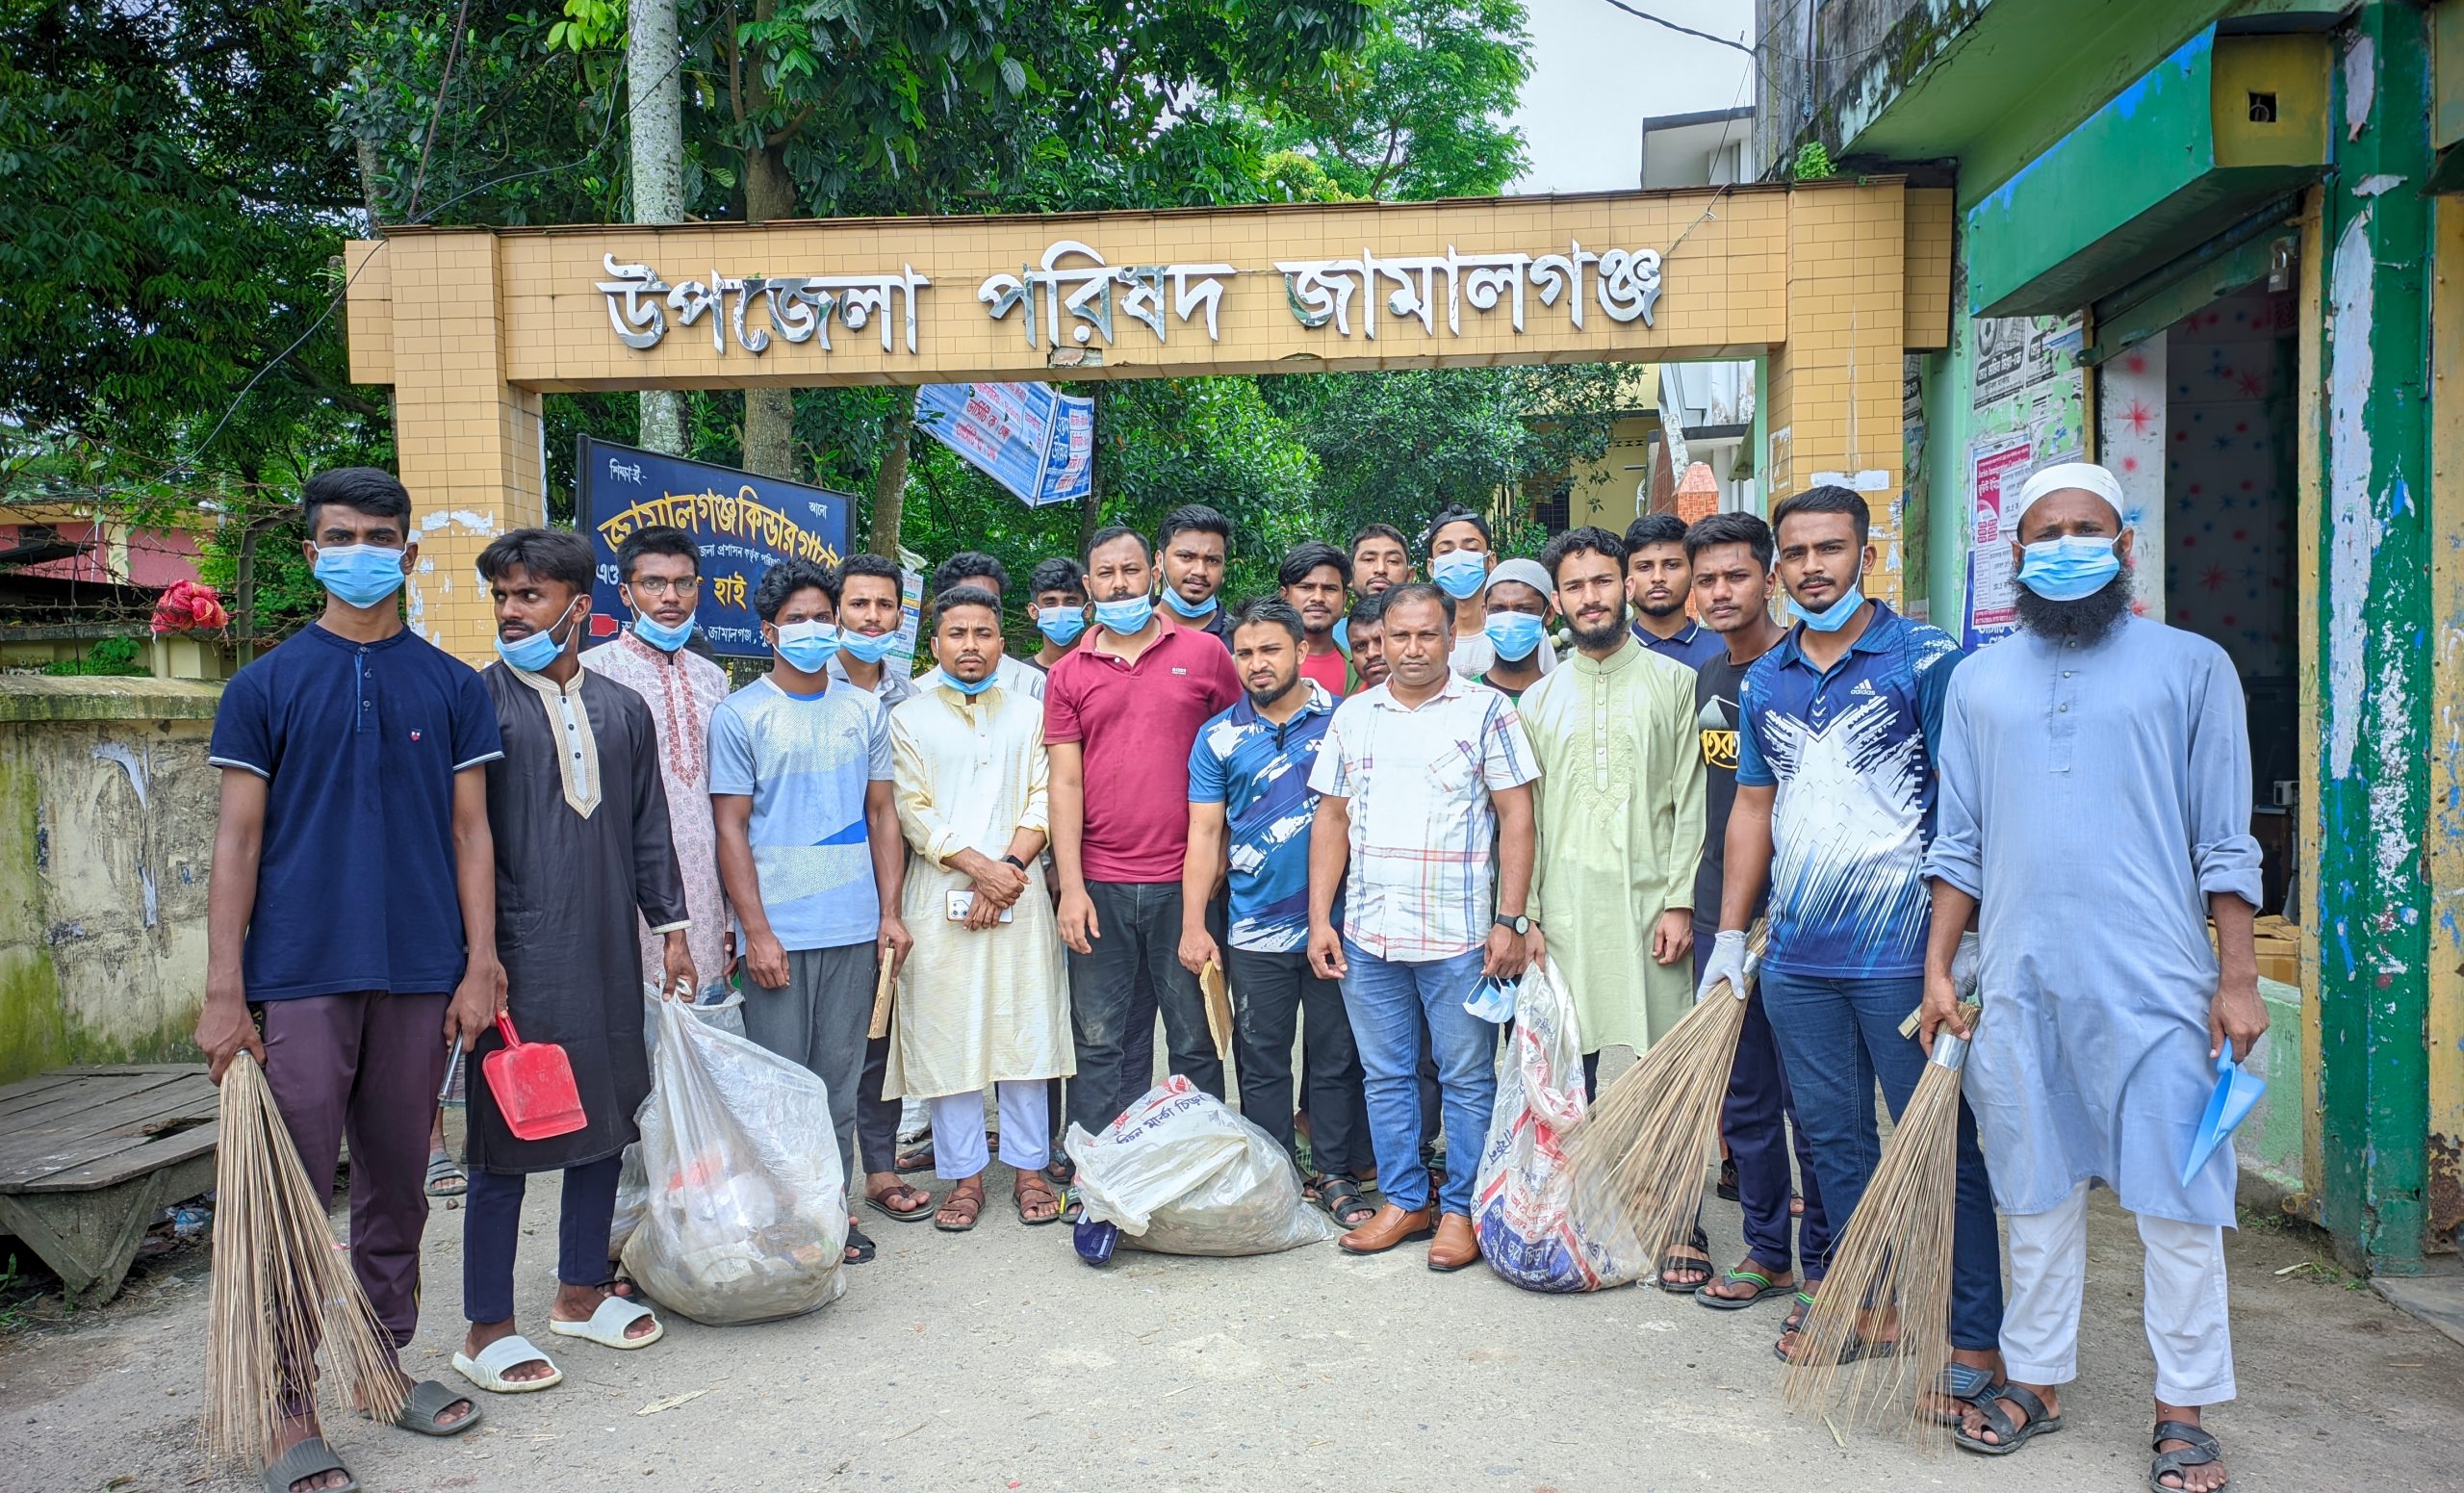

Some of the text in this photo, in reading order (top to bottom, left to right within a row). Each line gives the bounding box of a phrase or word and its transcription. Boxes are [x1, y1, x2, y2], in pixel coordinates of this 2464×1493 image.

[594, 238, 1665, 355] উপজেলা পরিষদ জামালগঞ্জ
[716, 543, 743, 558] প্রশাসন
[713, 571, 747, 610] হাই
[1142, 1106, 1175, 1129] মার্কা
